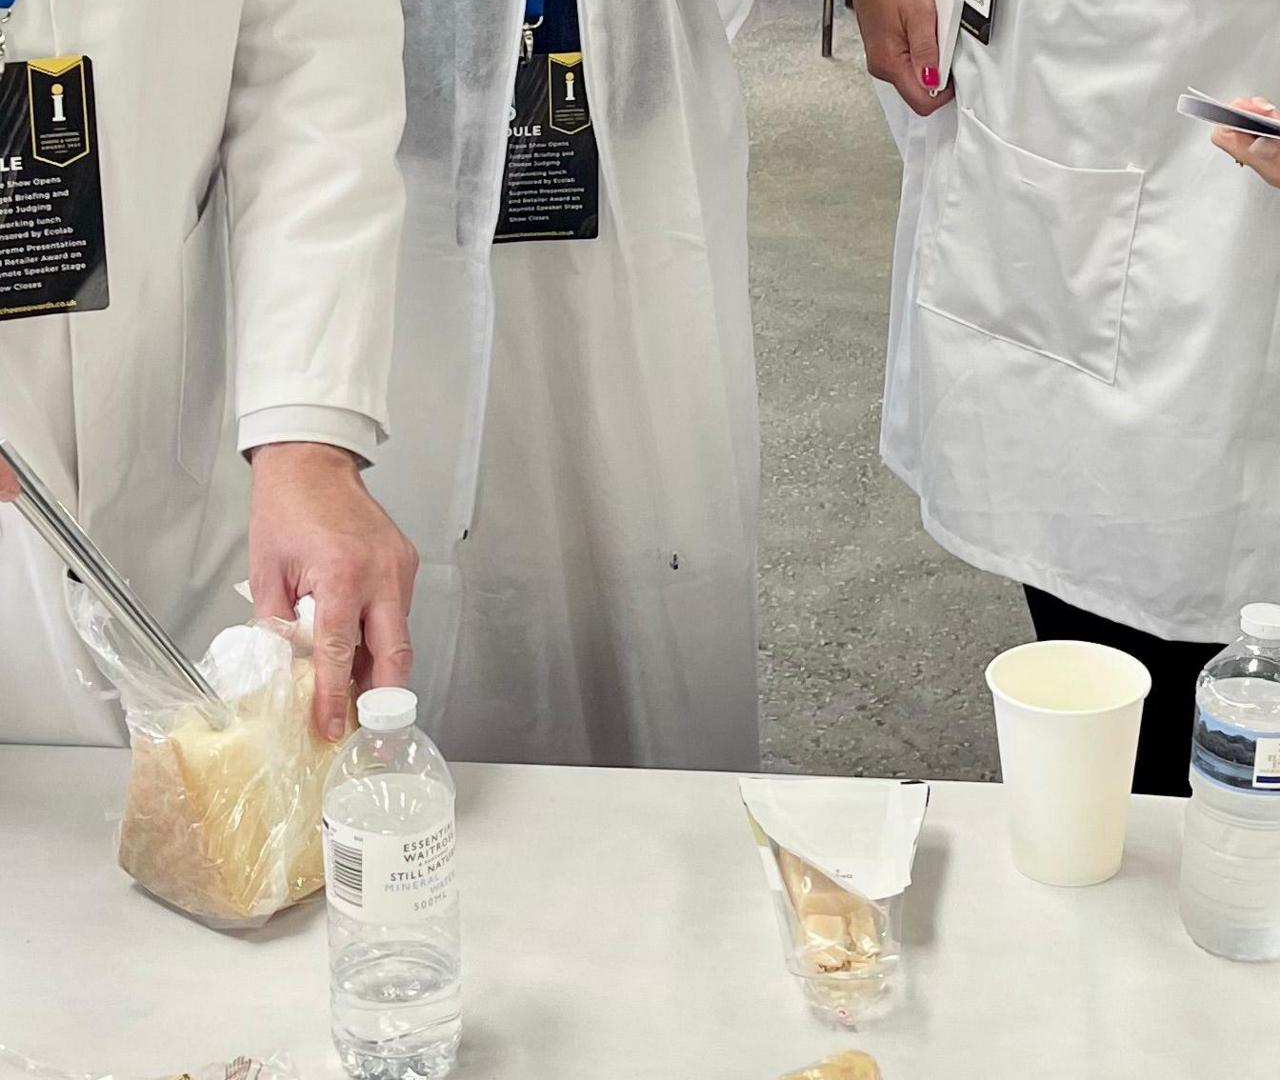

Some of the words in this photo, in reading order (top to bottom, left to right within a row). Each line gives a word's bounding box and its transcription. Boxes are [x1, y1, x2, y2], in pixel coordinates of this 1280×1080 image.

[6, 180, 31, 189] Show
[32, 176, 62, 186] Opens
[14, 191, 51, 202] Briefing
[52, 189, 70, 198] and
[15, 204, 52, 214] Judging
[36, 215, 62, 225] lunch
[30, 230, 42, 239] by
[43, 226, 74, 236] Ecolab
[26, 239, 87, 252] Presentations
[4, 256, 38, 267] Retailer
[40, 251, 69, 262] Award
[23, 265, 60, 276] Speaker
[60, 262, 87, 272] Stage
[13, 281, 43, 291] Closes
[390, 869, 423, 882] STILL
[413, 891, 448, 912] 500ML
